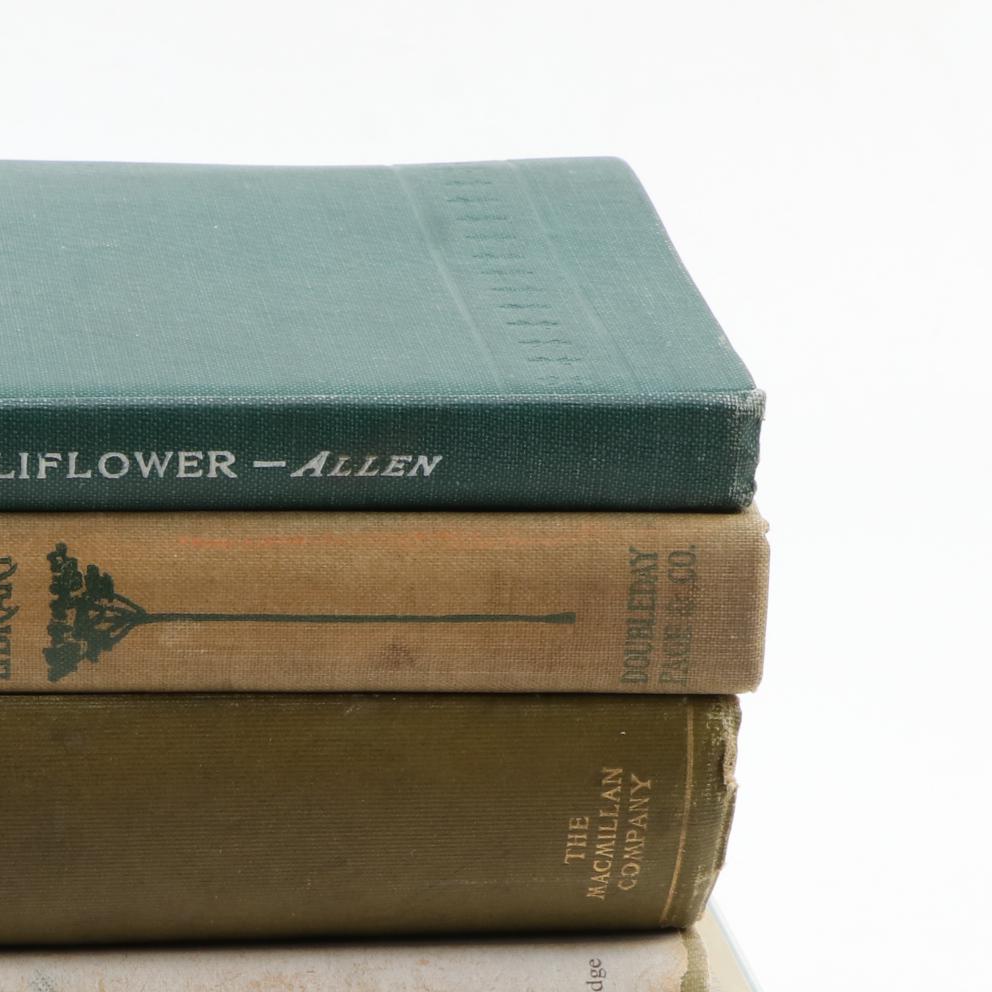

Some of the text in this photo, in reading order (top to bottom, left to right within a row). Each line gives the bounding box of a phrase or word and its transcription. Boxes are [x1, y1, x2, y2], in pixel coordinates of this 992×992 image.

[620, 545, 659, 684] DOUBLEDAY
[564, 816, 589, 865] THE
[585, 766, 624, 901] MACMILLAN
[617, 773, 652, 891] COMPANY
